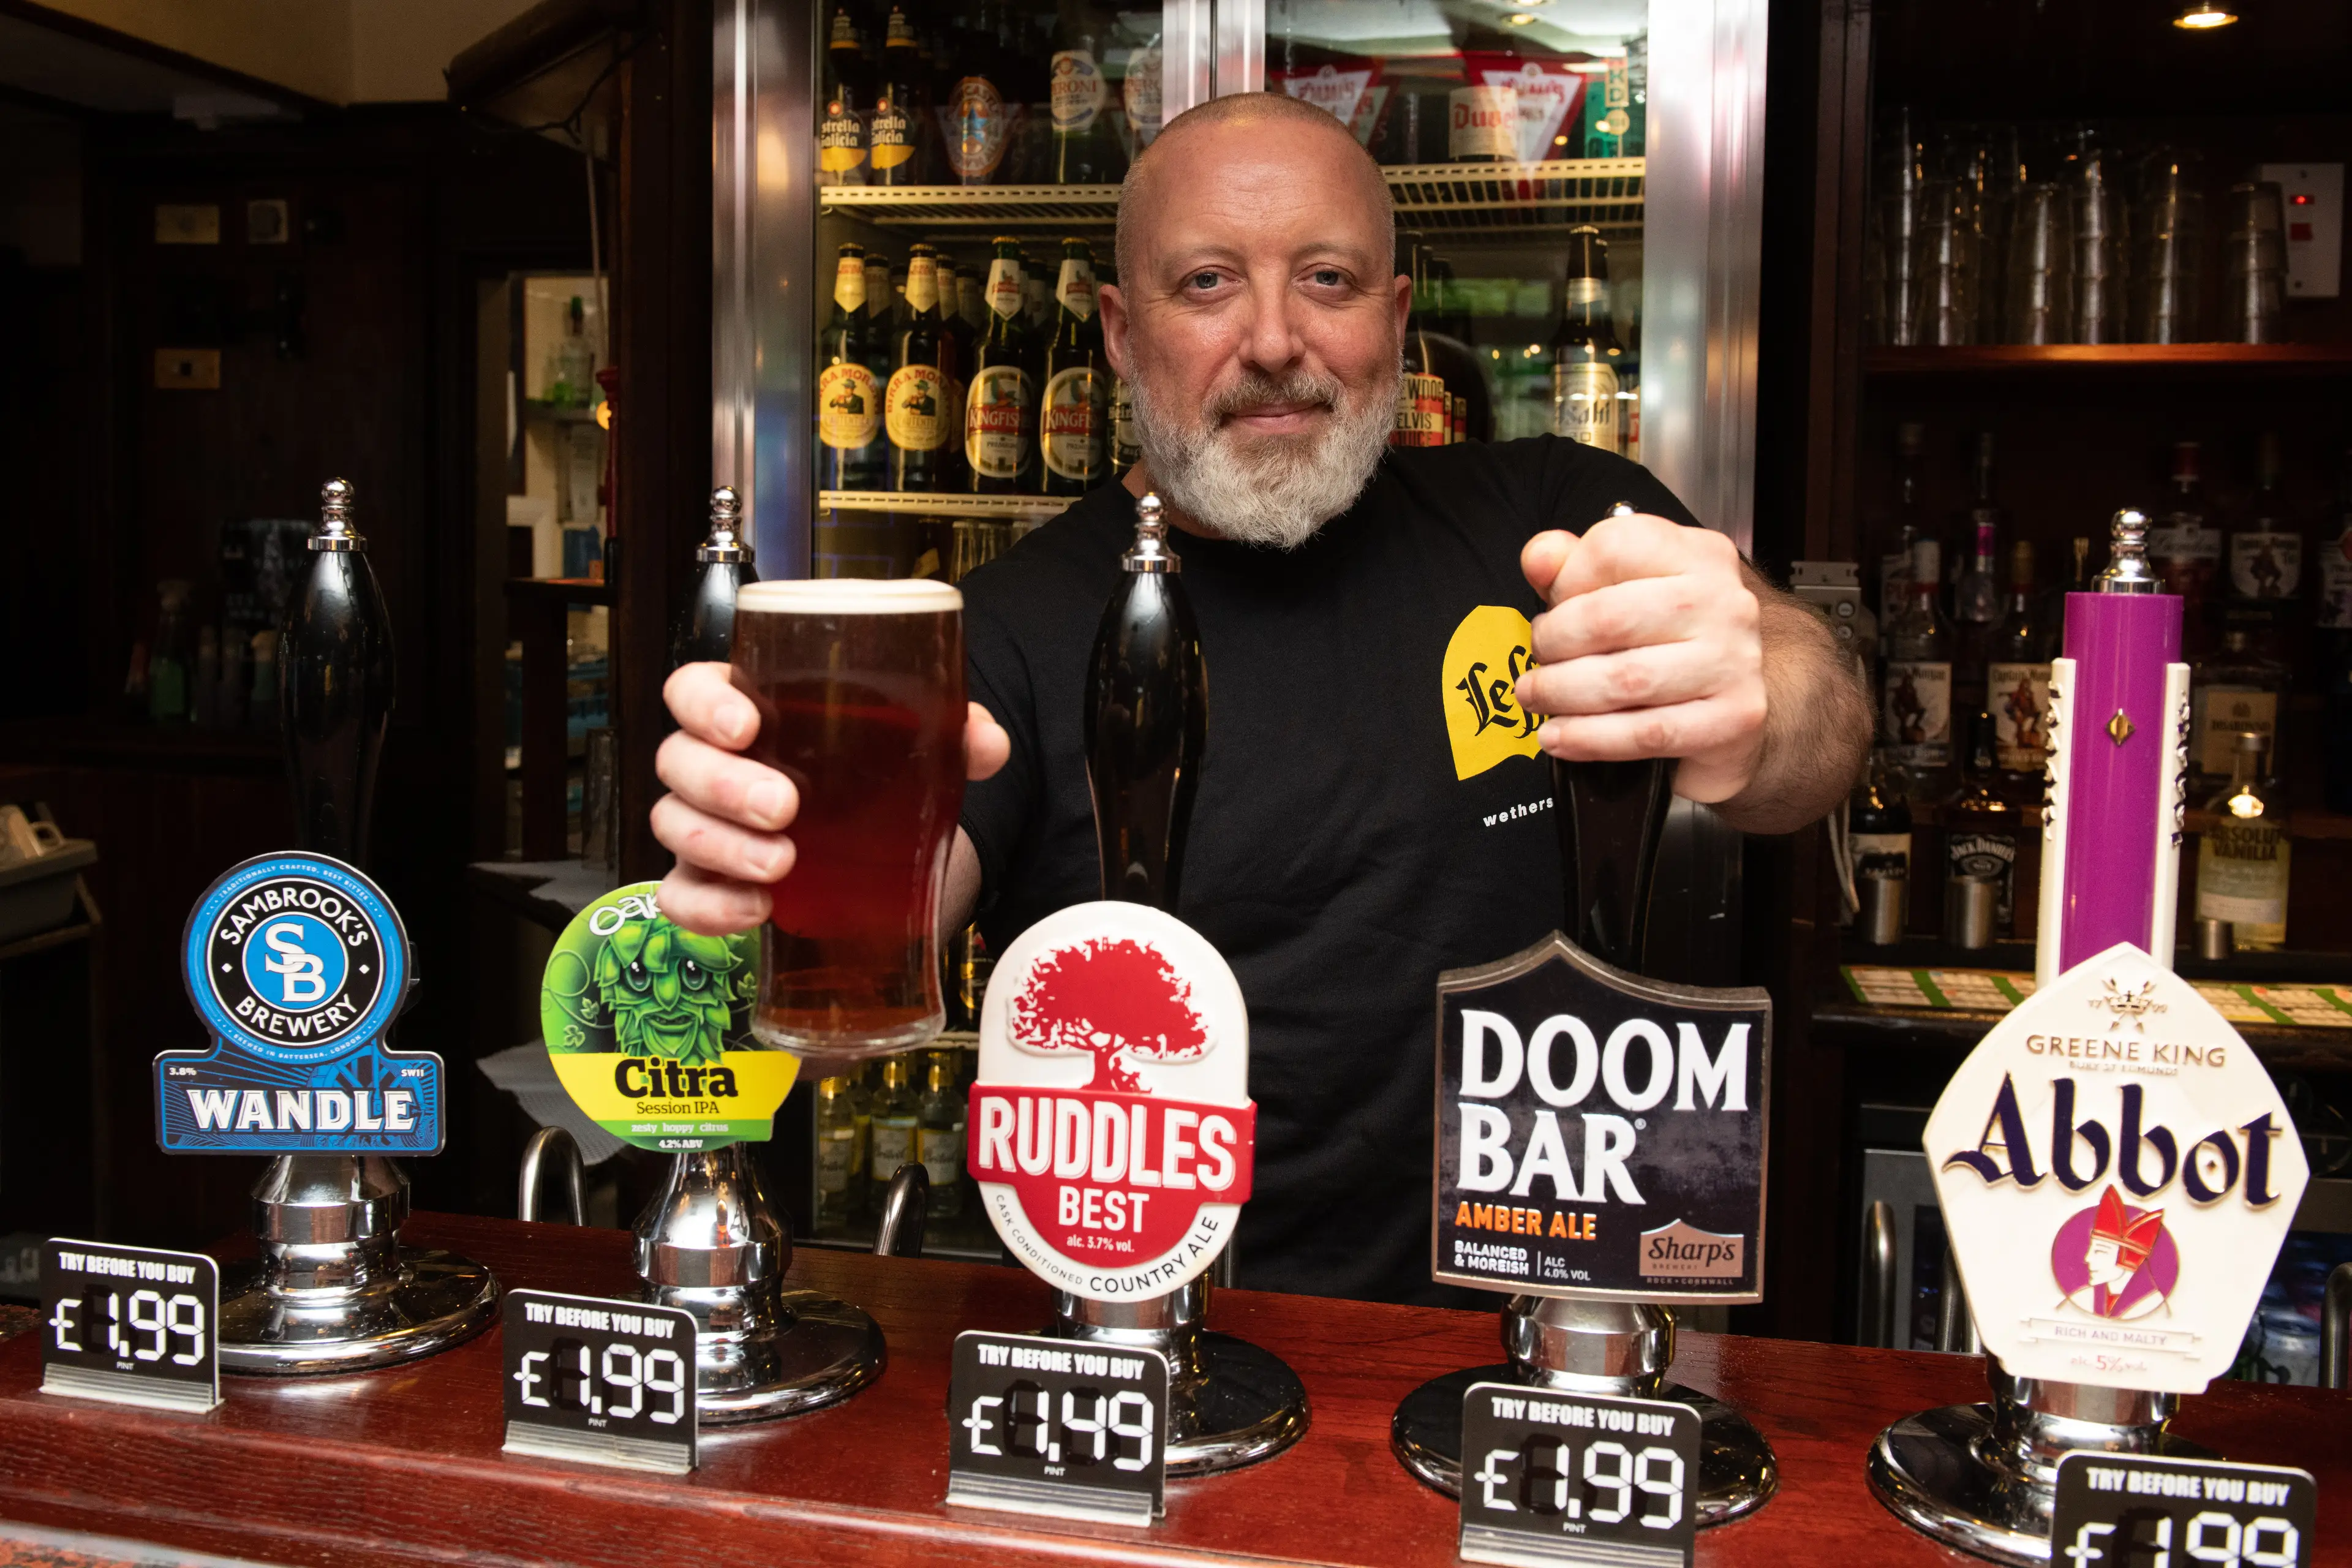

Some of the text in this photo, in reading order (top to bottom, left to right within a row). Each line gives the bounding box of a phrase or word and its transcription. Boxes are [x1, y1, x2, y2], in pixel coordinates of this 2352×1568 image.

[1051, 80, 1097, 95] ERONI
[821, 119, 859, 133] strella
[872, 115, 906, 131] strella
[969, 408, 1024, 427] KINGFIS
[1396, 412, 1432, 429] ELVIS
[1483, 797, 1554, 827] wethers
[218, 865, 276, 899] TRADITIONALLY
[323, 870, 343, 881] BEST
[344, 880, 369, 902] BITTER
[221, 887, 369, 946] SAMBROOK'S
[589, 892, 663, 936] Oak
[236, 993, 358, 1036] BREWERY
[233, 1033, 263, 1053] BREWED
[330, 1034, 362, 1055] LONDON
[1459, 1009, 1752, 1112] DOOM
[2026, 1034, 2226, 1068] GREENE KING
[168, 1067, 197, 1077] 3.8%
[614, 1056, 739, 1099] Citra
[186, 1089, 417, 1131] WANDLE
[636, 1101, 720, 1115] Session IPA
[631, 1122, 729, 1134] zesty hoppy citrus
[658, 1139, 704, 1149] 4.2% ABV
[978, 1096, 1237, 1192] RUDDLES
[1942, 1070, 2283, 1209] Abbot
[1456, 1102, 1646, 1205] BAR
[1058, 1185, 1150, 1233] BEST
[1455, 1200, 1597, 1241] AMBER ALE
[996, 1194, 1219, 1293] CASK CONDITIONED COUNTRY ALE
[1066, 1235, 1135, 1253] alc. 3.7% vol.
[1454, 1240, 1528, 1262] BALANCED
[1648, 1235, 1736, 1267] Sharp's
[59, 1251, 86, 1272] TRY
[86, 1255, 136, 1278] BEFORE
[137, 1261, 166, 1281] YOU
[167, 1264, 196, 1284] BUY
[1454, 1254, 1529, 1275] & MOREISH
[1544, 1256, 1566, 1267] ALC
[1544, 1268, 1591, 1281] 4.0% VOL
[48, 1289, 205, 1366] £1.99
[524, 1302, 675, 1339] TRY BEFORE YOU BUY
[2054, 1325, 2168, 1346] RICH AND MALTY
[116, 1361, 134, 1371] PINT
[978, 1344, 1145, 1381] TRY BEFORE YOU BUY
[2095, 1354, 2124, 1372] 5%
[513, 1343, 685, 1424] £1.99
[588, 1417, 608, 1428] PINT
[962, 1390, 1154, 1472] £1.49
[1491, 1396, 1675, 1437] TRY BEFORE YOU BUY
[1044, 1466, 1066, 1477] PINT
[1474, 1441, 1684, 1529] £1.99
[2086, 1467, 2291, 1507] TRY BEFORE YOU BUY
[1562, 1522, 1587, 1534] PINT
[2064, 1510, 2300, 1568] £199
